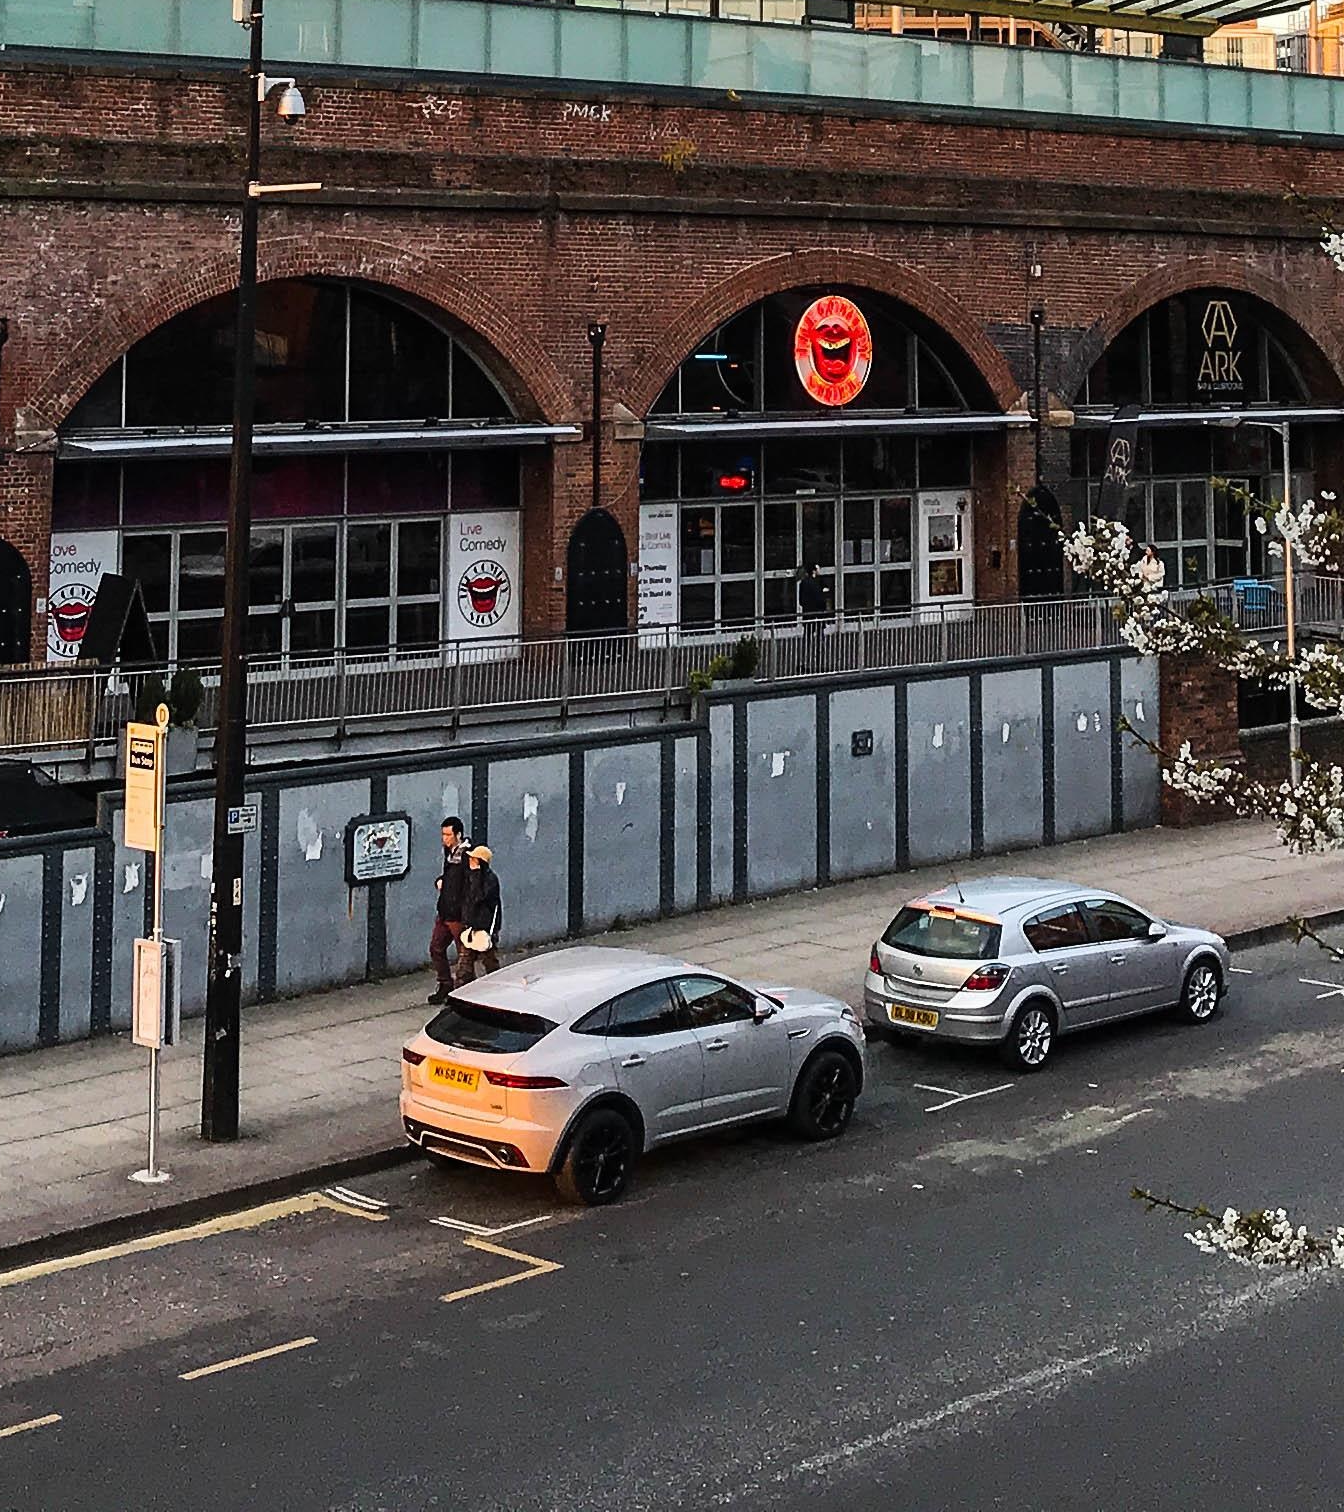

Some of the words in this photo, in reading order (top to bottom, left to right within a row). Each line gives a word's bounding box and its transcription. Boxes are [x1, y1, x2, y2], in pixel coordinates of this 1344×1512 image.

[1197, 351, 1243, 381] ARK
[460, 521, 482, 536] Live
[50, 544, 77, 557] ove
[459, 536, 507, 553] Comedy
[132, 754, 141, 765] Bus
[231, 811, 238, 823] P
